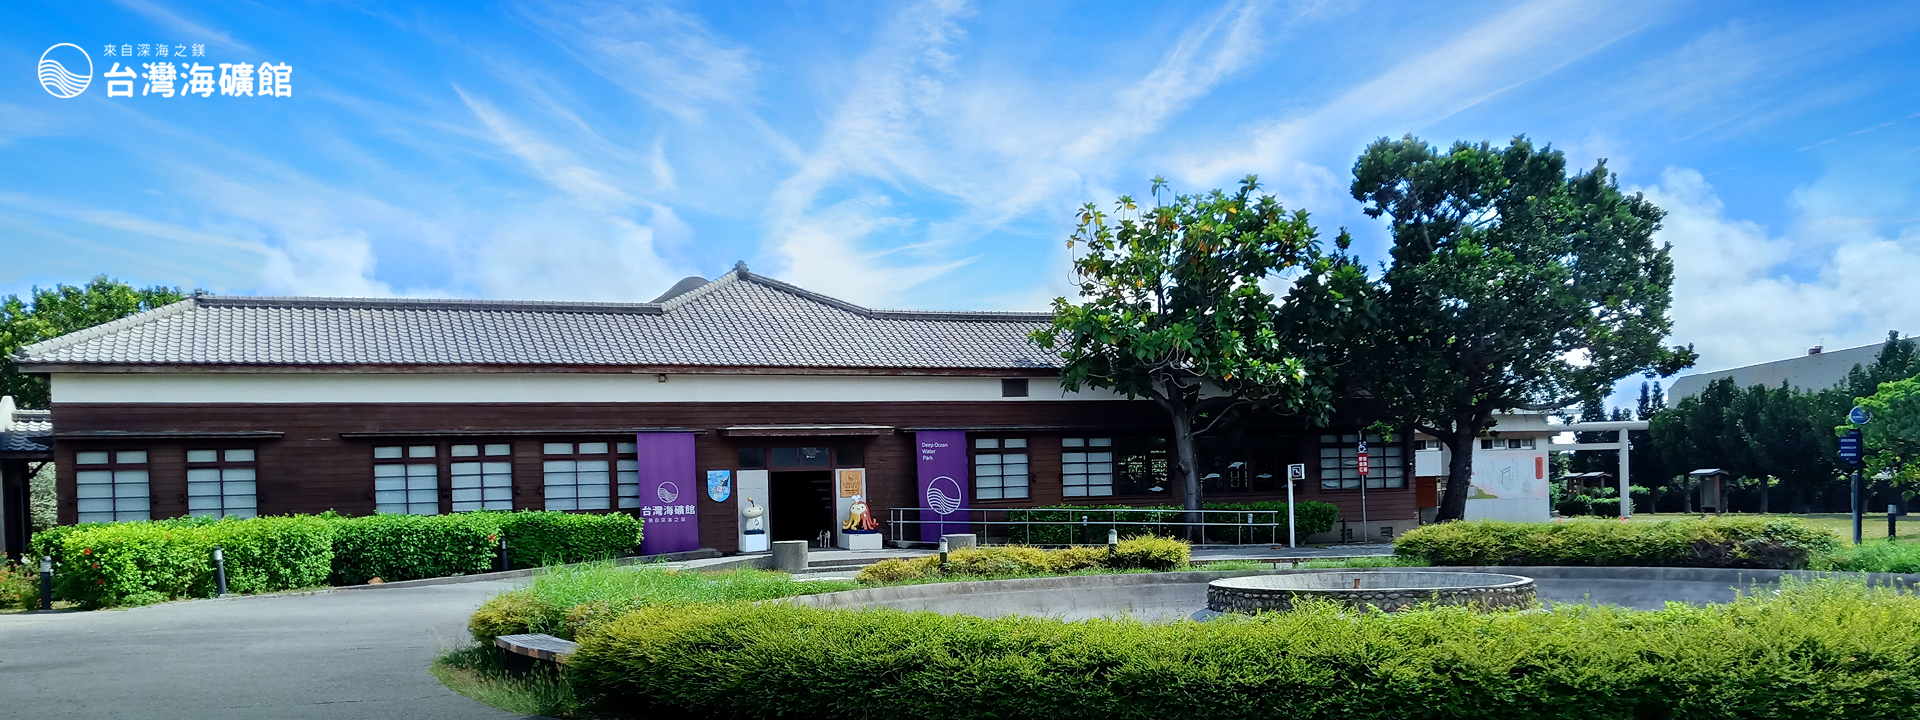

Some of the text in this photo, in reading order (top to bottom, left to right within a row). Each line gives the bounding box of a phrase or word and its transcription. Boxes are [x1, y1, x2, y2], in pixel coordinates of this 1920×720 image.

[641, 505, 696, 516] 台灣海礦館
